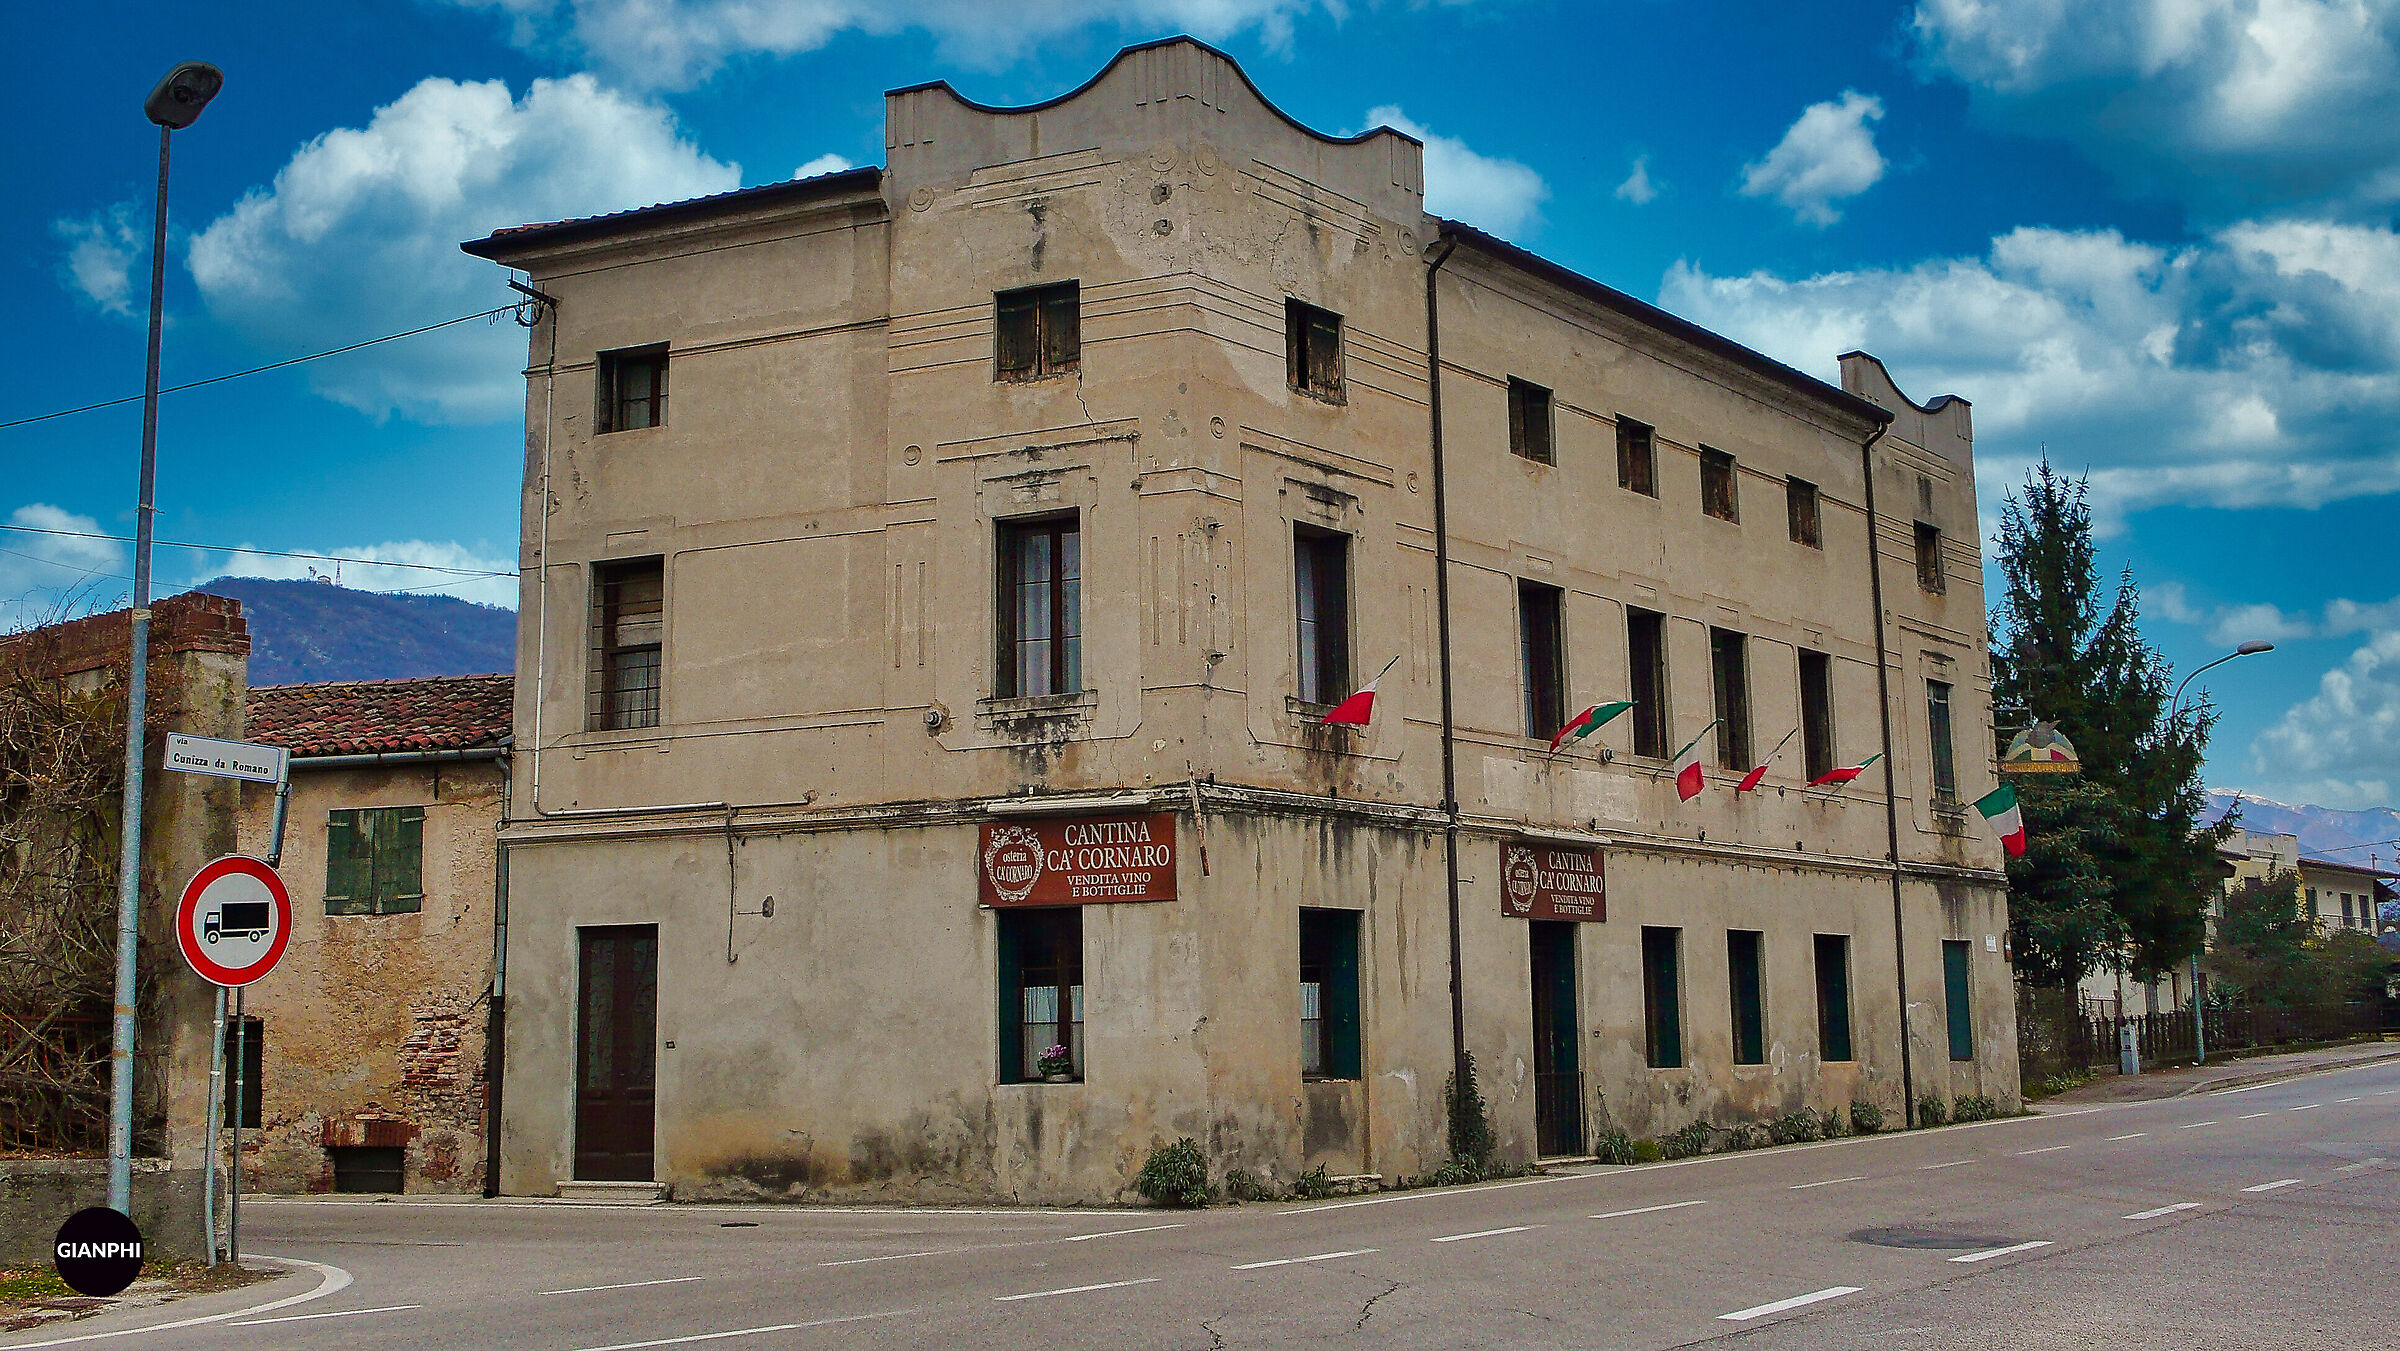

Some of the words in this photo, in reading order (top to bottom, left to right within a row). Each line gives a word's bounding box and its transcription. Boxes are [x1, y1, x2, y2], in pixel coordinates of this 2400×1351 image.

[176, 737, 188, 745] via
[173, 752, 209, 767] Cunizza
[214, 757, 226, 769] da
[232, 760, 269, 775] Romano
[1064, 821, 1151, 846] CANTINA
[1002, 849, 1027, 863] osteria
[1078, 844, 1170, 869] CORNARO
[1548, 851, 1594, 873] CANTINA
[1067, 873, 1119, 886] VENDITA
[1121, 871, 1151, 883] VINO
[1556, 872, 1603, 894] CORNARO
[1072, 886, 1079, 898] E
[1082, 884, 1146, 897] BOTTIGLIE
[1550, 894, 1578, 905] VENDITA
[1578, 896, 1595, 906] VINO
[1559, 905, 1592, 915] BOTTIGLIE
